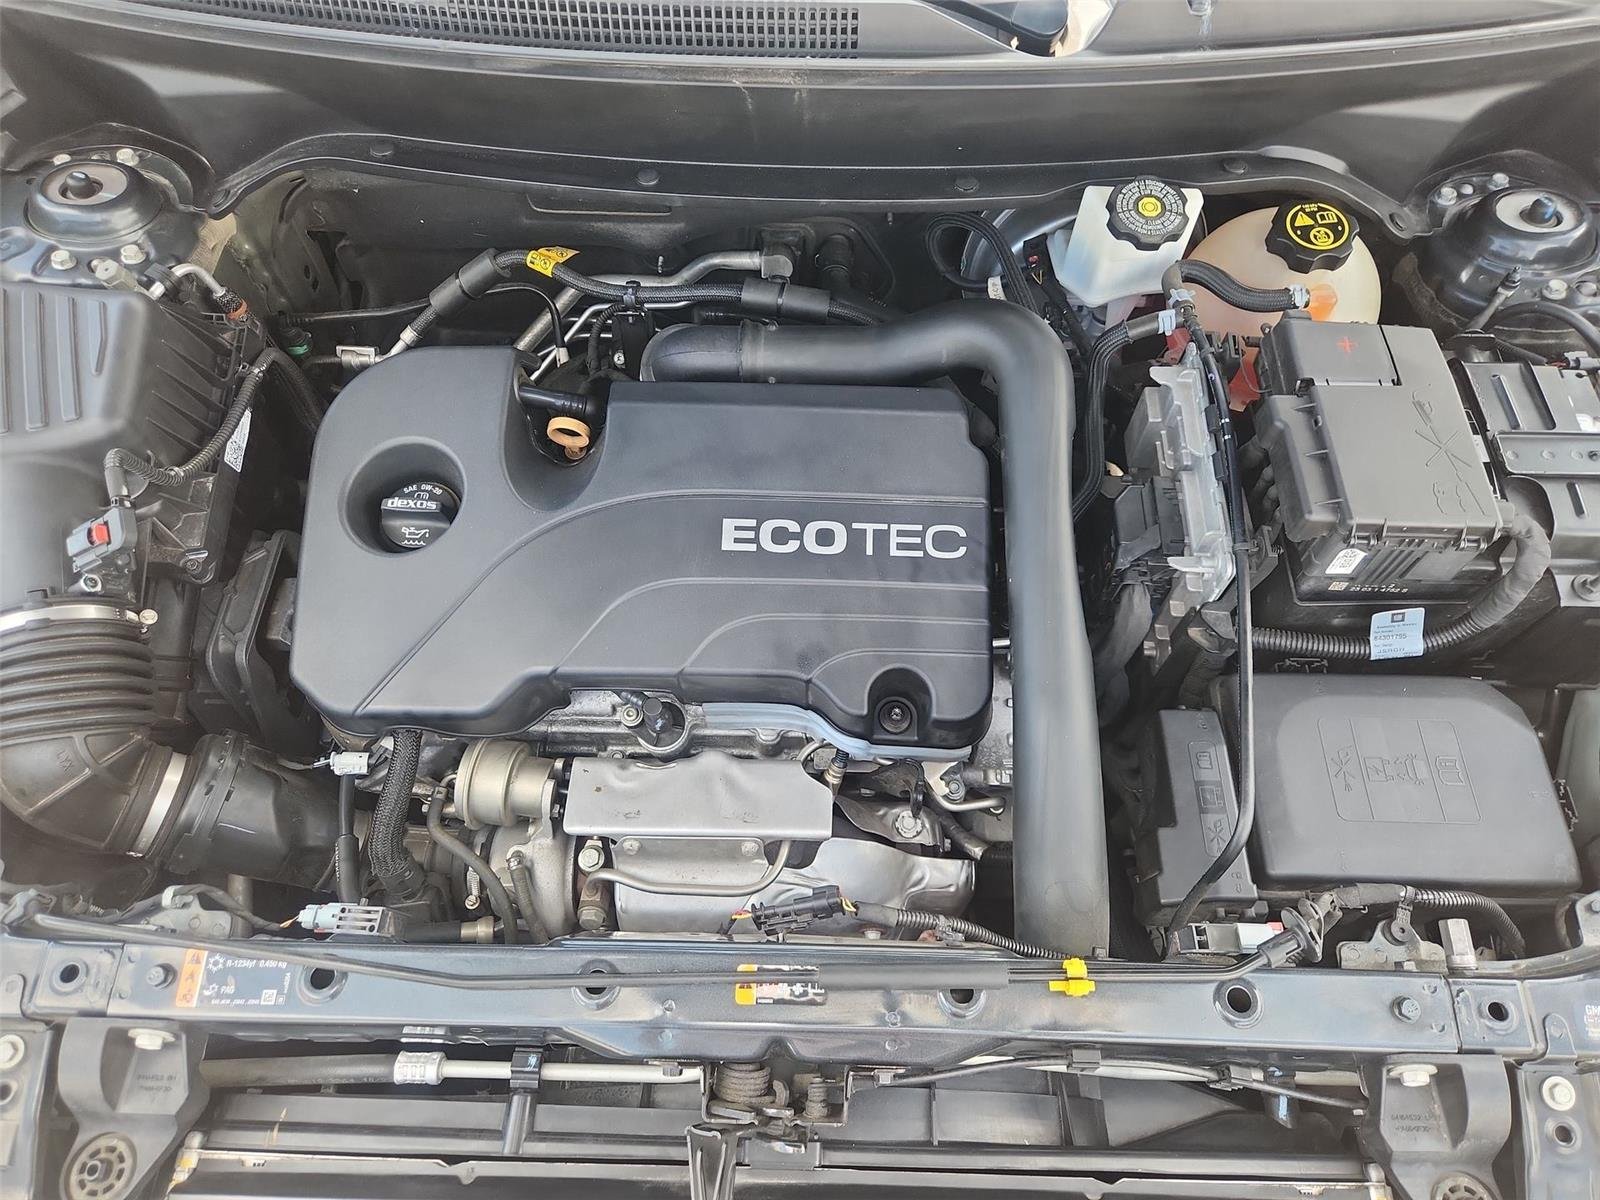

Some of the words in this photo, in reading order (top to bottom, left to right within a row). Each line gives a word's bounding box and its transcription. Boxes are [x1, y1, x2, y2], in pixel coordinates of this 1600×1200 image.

[403, 484, 418, 494] SAE
[420, 483, 443, 495] 0W-20
[387, 496, 437, 510] dexos
[721, 518, 968, 559] ECOTEC
